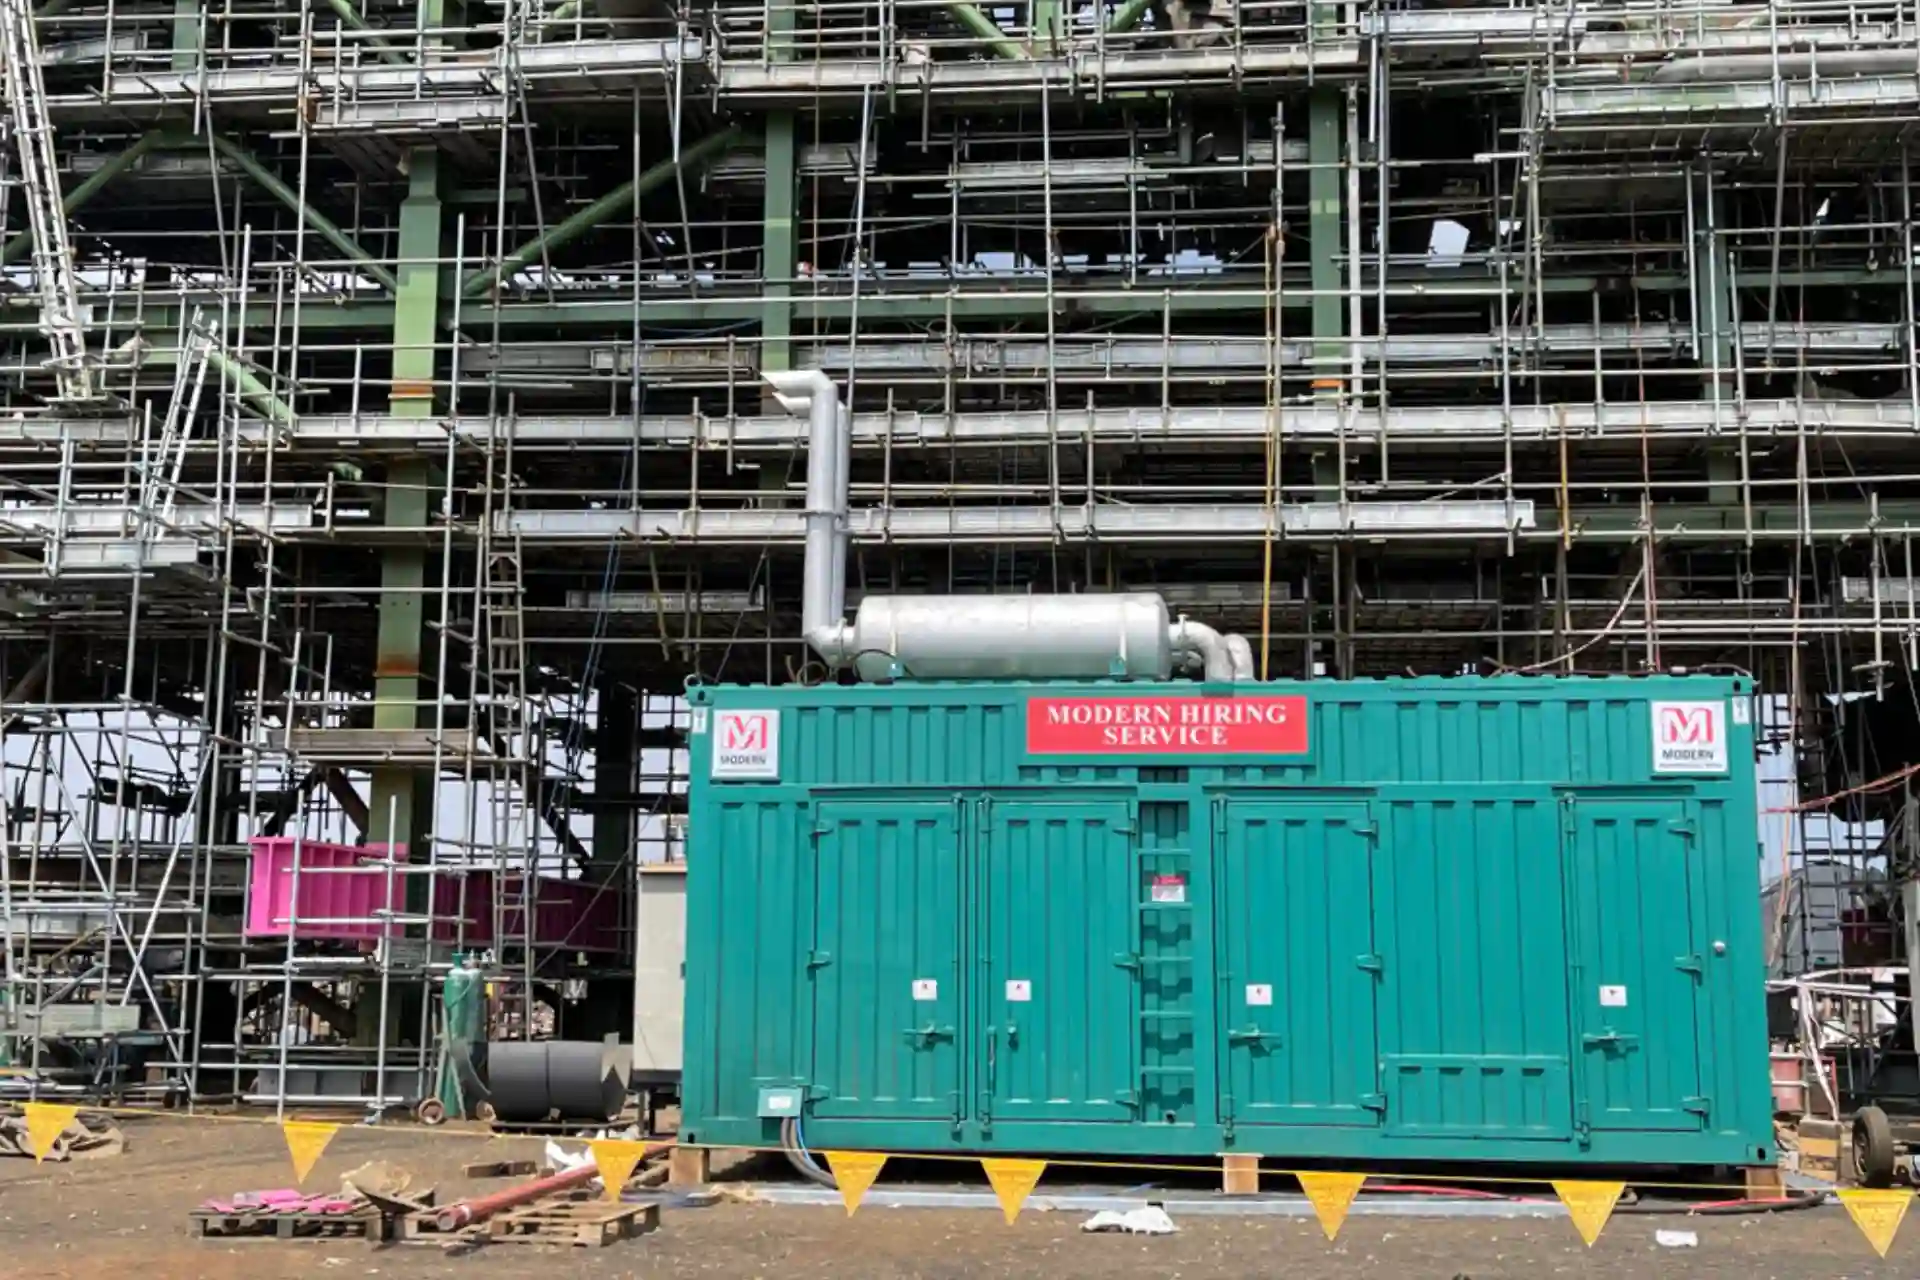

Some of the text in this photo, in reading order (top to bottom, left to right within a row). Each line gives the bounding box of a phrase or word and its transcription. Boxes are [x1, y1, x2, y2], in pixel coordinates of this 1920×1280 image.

[1047, 704, 1287, 725] MODERN HIRING
[1102, 725, 1229, 745] SERVICE
[720, 755, 766, 765] MODERN
[1662, 749, 1714, 760] MODERN
